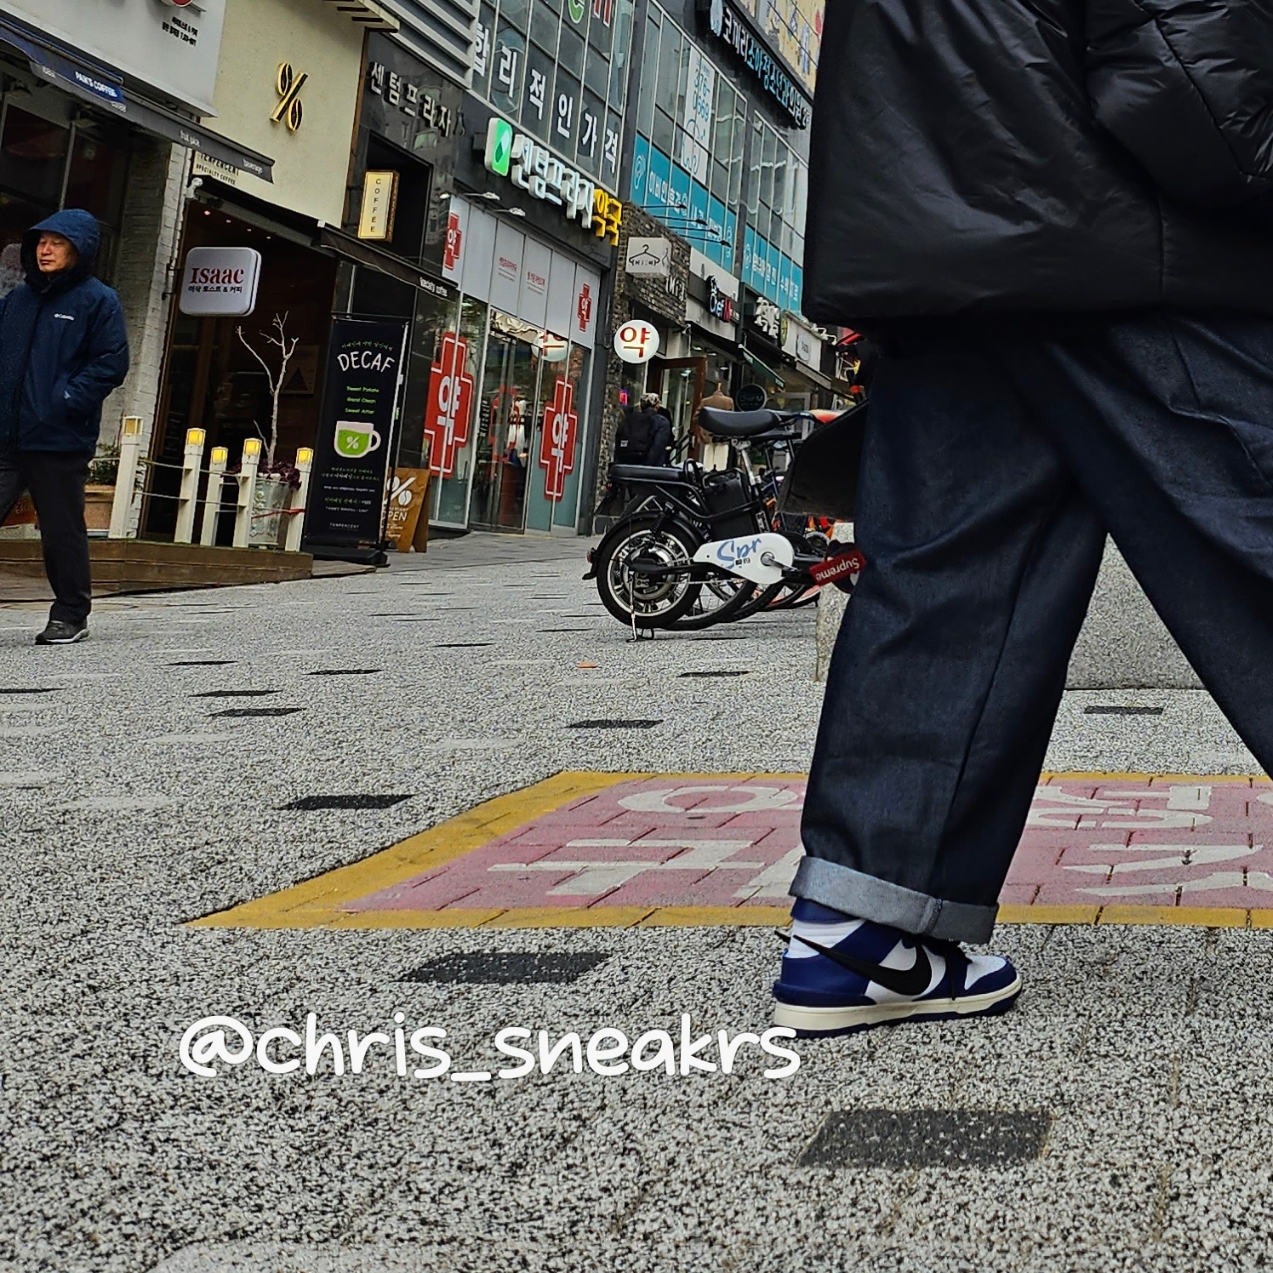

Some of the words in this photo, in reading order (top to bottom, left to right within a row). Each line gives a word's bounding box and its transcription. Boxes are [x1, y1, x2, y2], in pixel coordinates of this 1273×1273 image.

[369, 59, 452, 139] 센텀프라자
[374, 177, 382, 235] COFFEE
[202, 285, 221, 293] 토스트
[229, 286, 242, 294] 커피
[336, 349, 396, 374] DECAF
[619, 326, 651, 358] 약
[437, 377, 460, 446] 약
[551, 408, 570, 472] 약
[815, 557, 860, 582] Supreme
